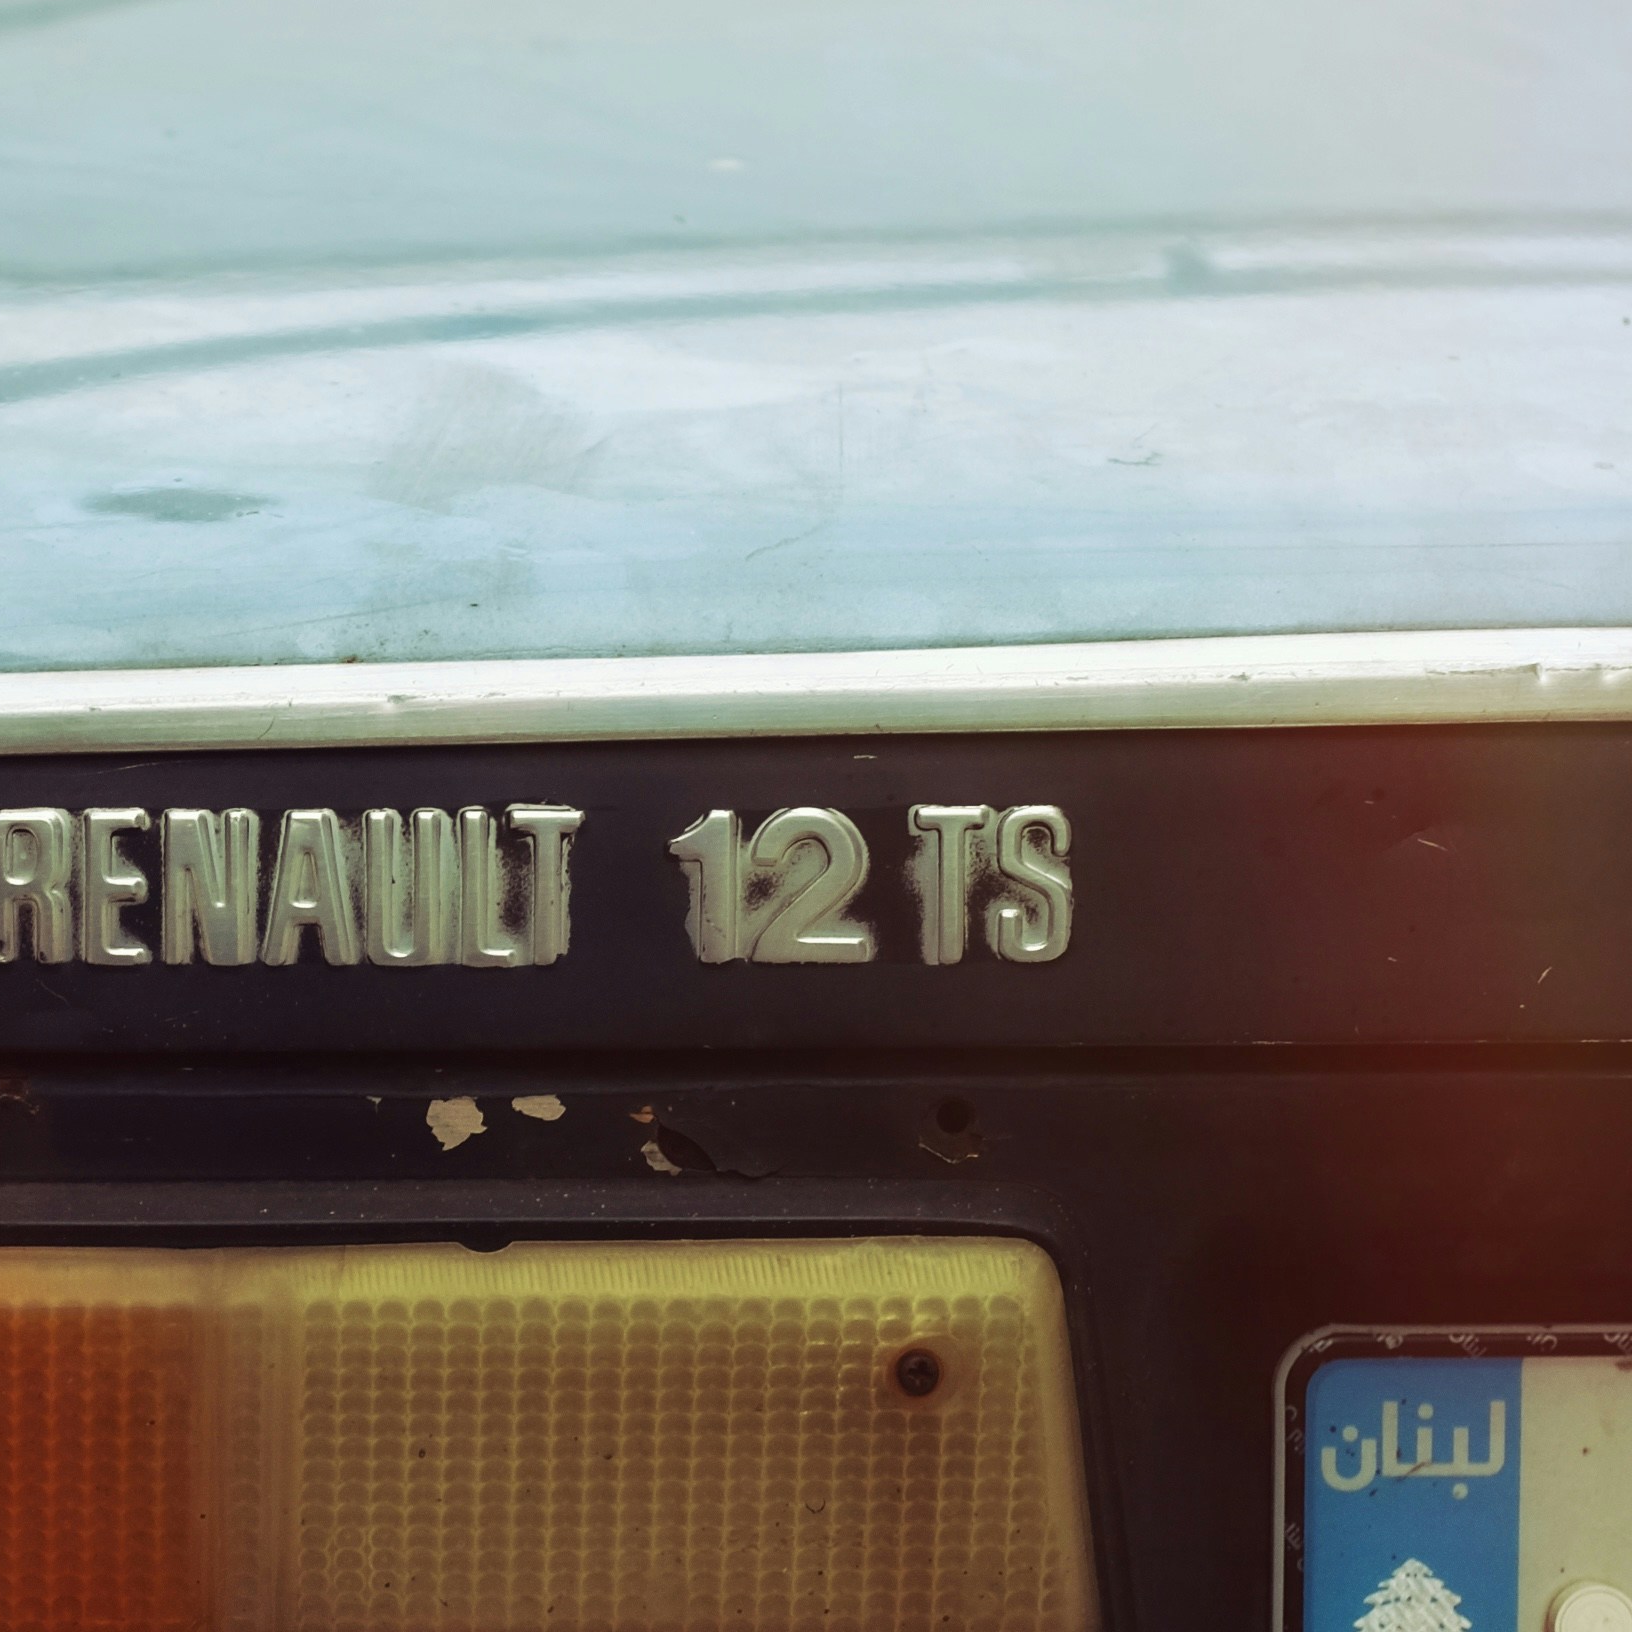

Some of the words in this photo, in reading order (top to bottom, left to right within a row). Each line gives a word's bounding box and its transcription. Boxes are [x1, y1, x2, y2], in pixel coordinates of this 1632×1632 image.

[668, 806, 876, 964] 12
[907, 804, 1072, 965] TS
[1321, 1400, 1506, 1500] لبنان
